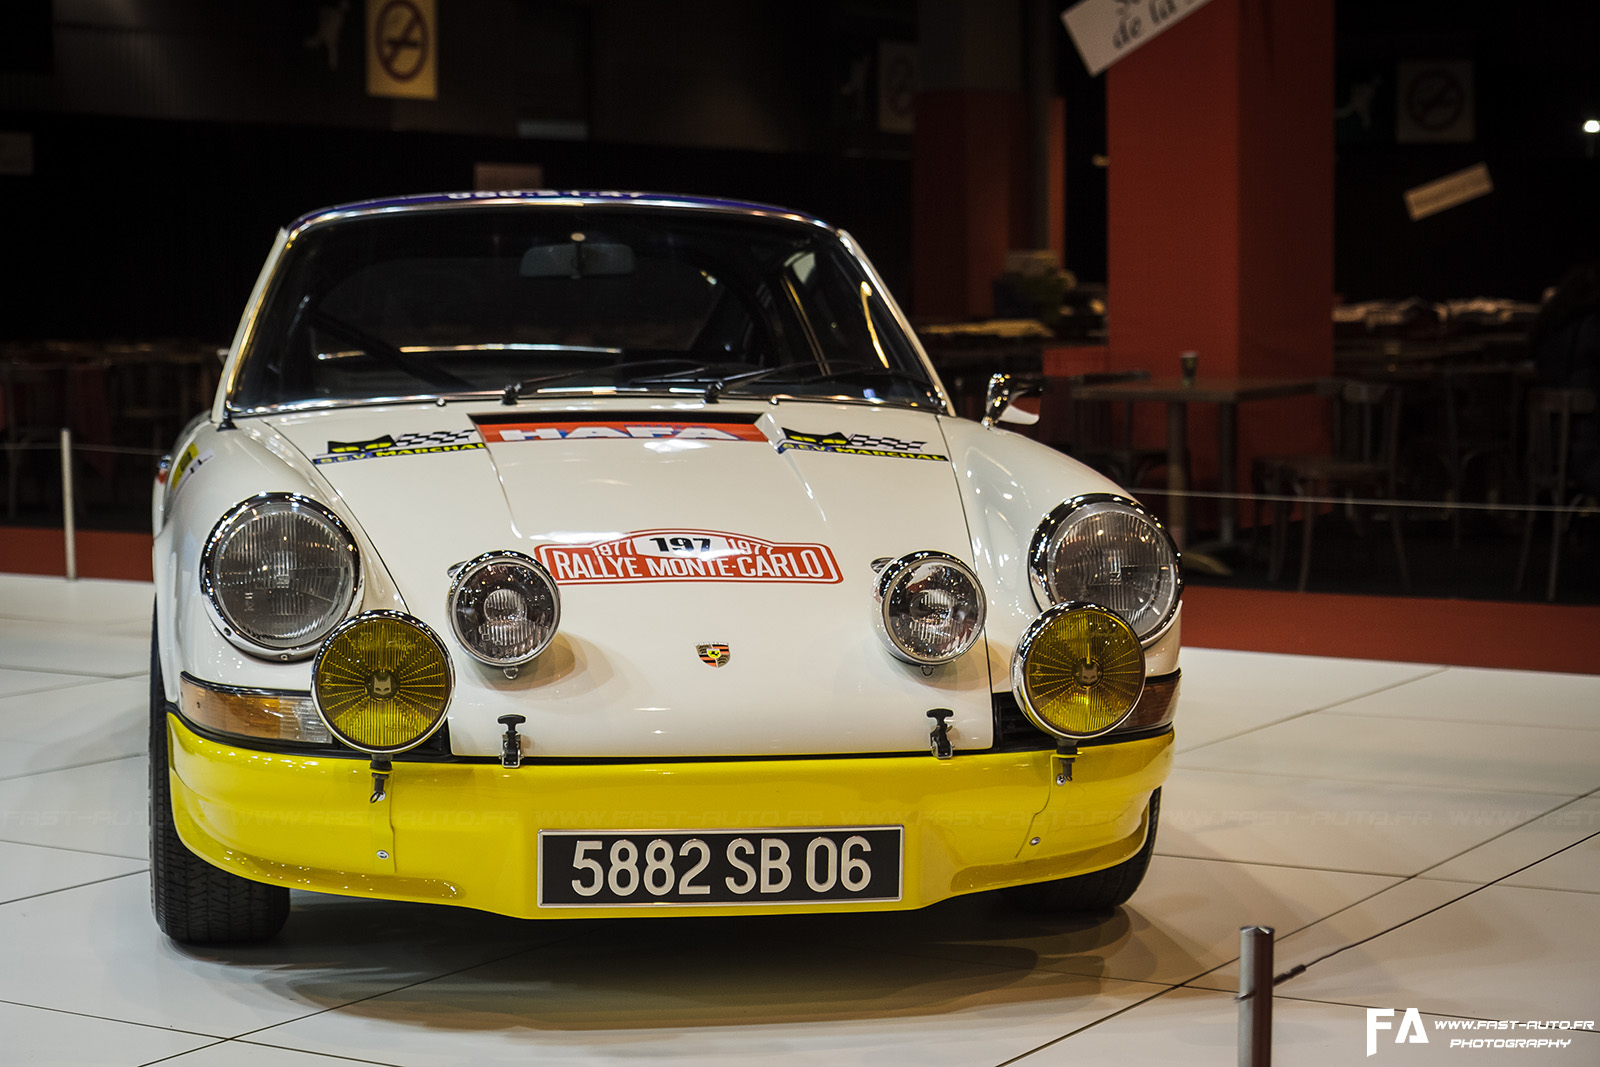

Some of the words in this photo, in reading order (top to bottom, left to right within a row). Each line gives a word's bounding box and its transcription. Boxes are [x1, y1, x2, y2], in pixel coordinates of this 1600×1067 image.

[499, 426, 742, 441] HAFA
[835, 447, 945, 461] MARCHAL
[592, 540, 633, 557] 1977
[649, 536, 711, 552] 197
[728, 538, 774, 556] 1977
[552, 550, 643, 579] RALLYE
[645, 550, 824, 578] MONTE-CARLO
[571, 838, 711, 897] 5882
[725, 837, 792, 895] SB
[805, 835, 872, 893] 06
